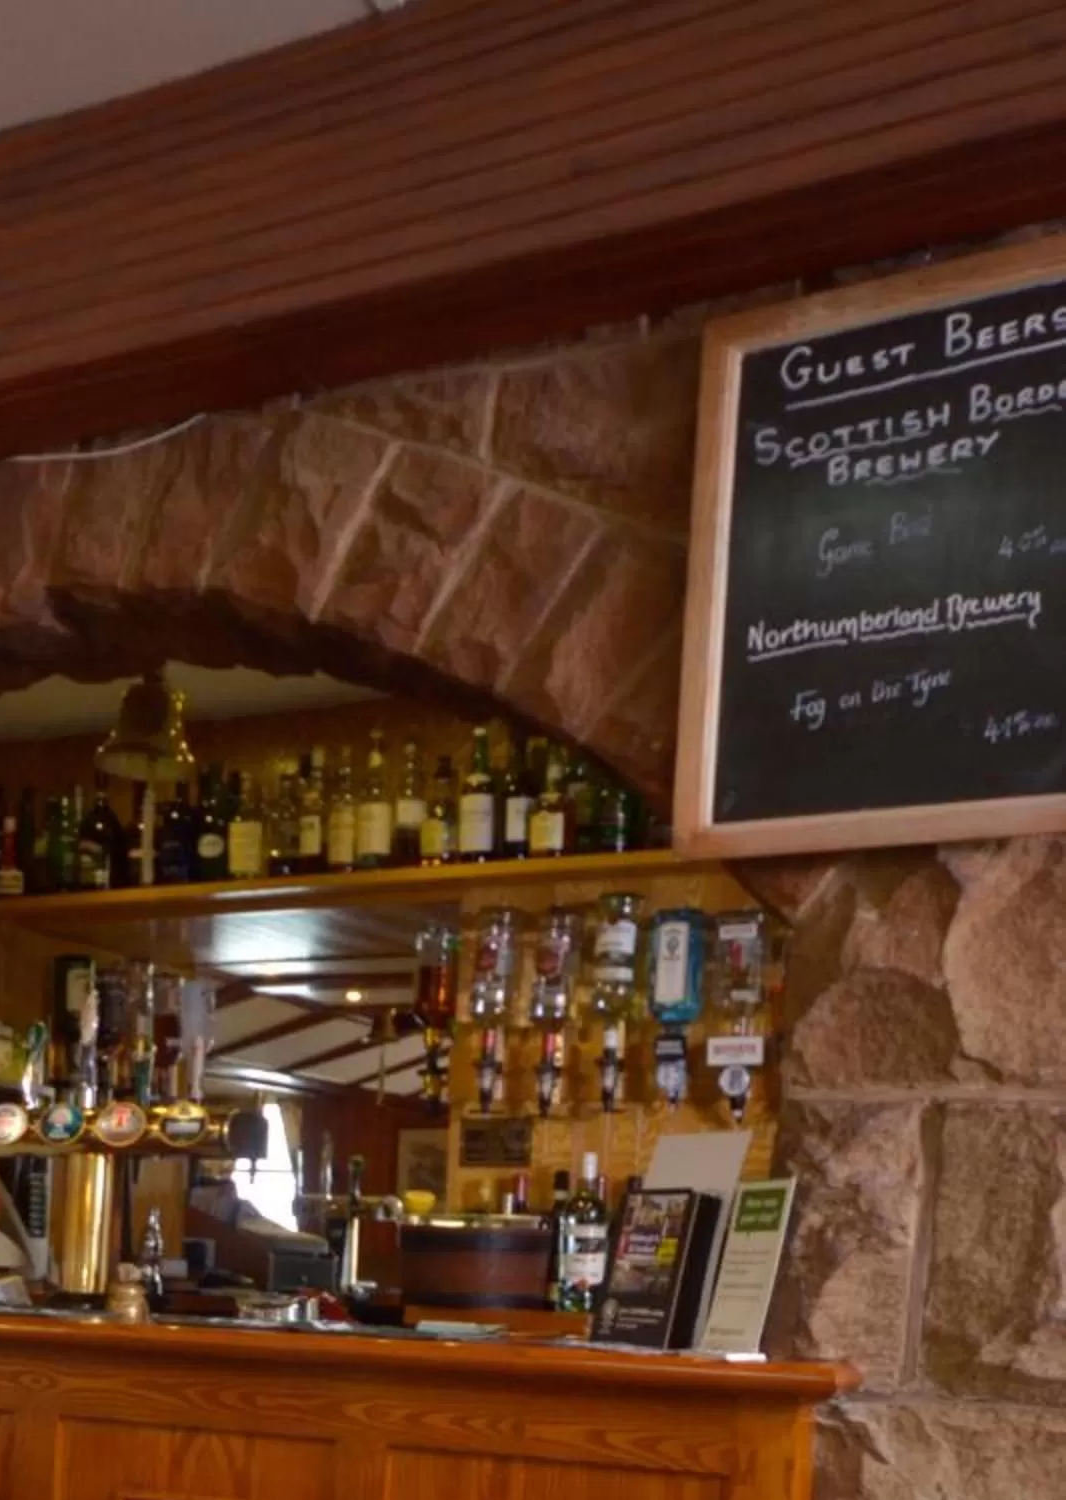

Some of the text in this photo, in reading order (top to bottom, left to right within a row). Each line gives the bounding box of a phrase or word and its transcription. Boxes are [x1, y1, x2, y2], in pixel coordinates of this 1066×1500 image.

[753, 402, 952, 466] SCOTTISH
[827, 430, 1000, 486] BREWERY
[746, 590, 1042, 652] Northumberland Brewery
[790, 689, 827, 731] Fog
